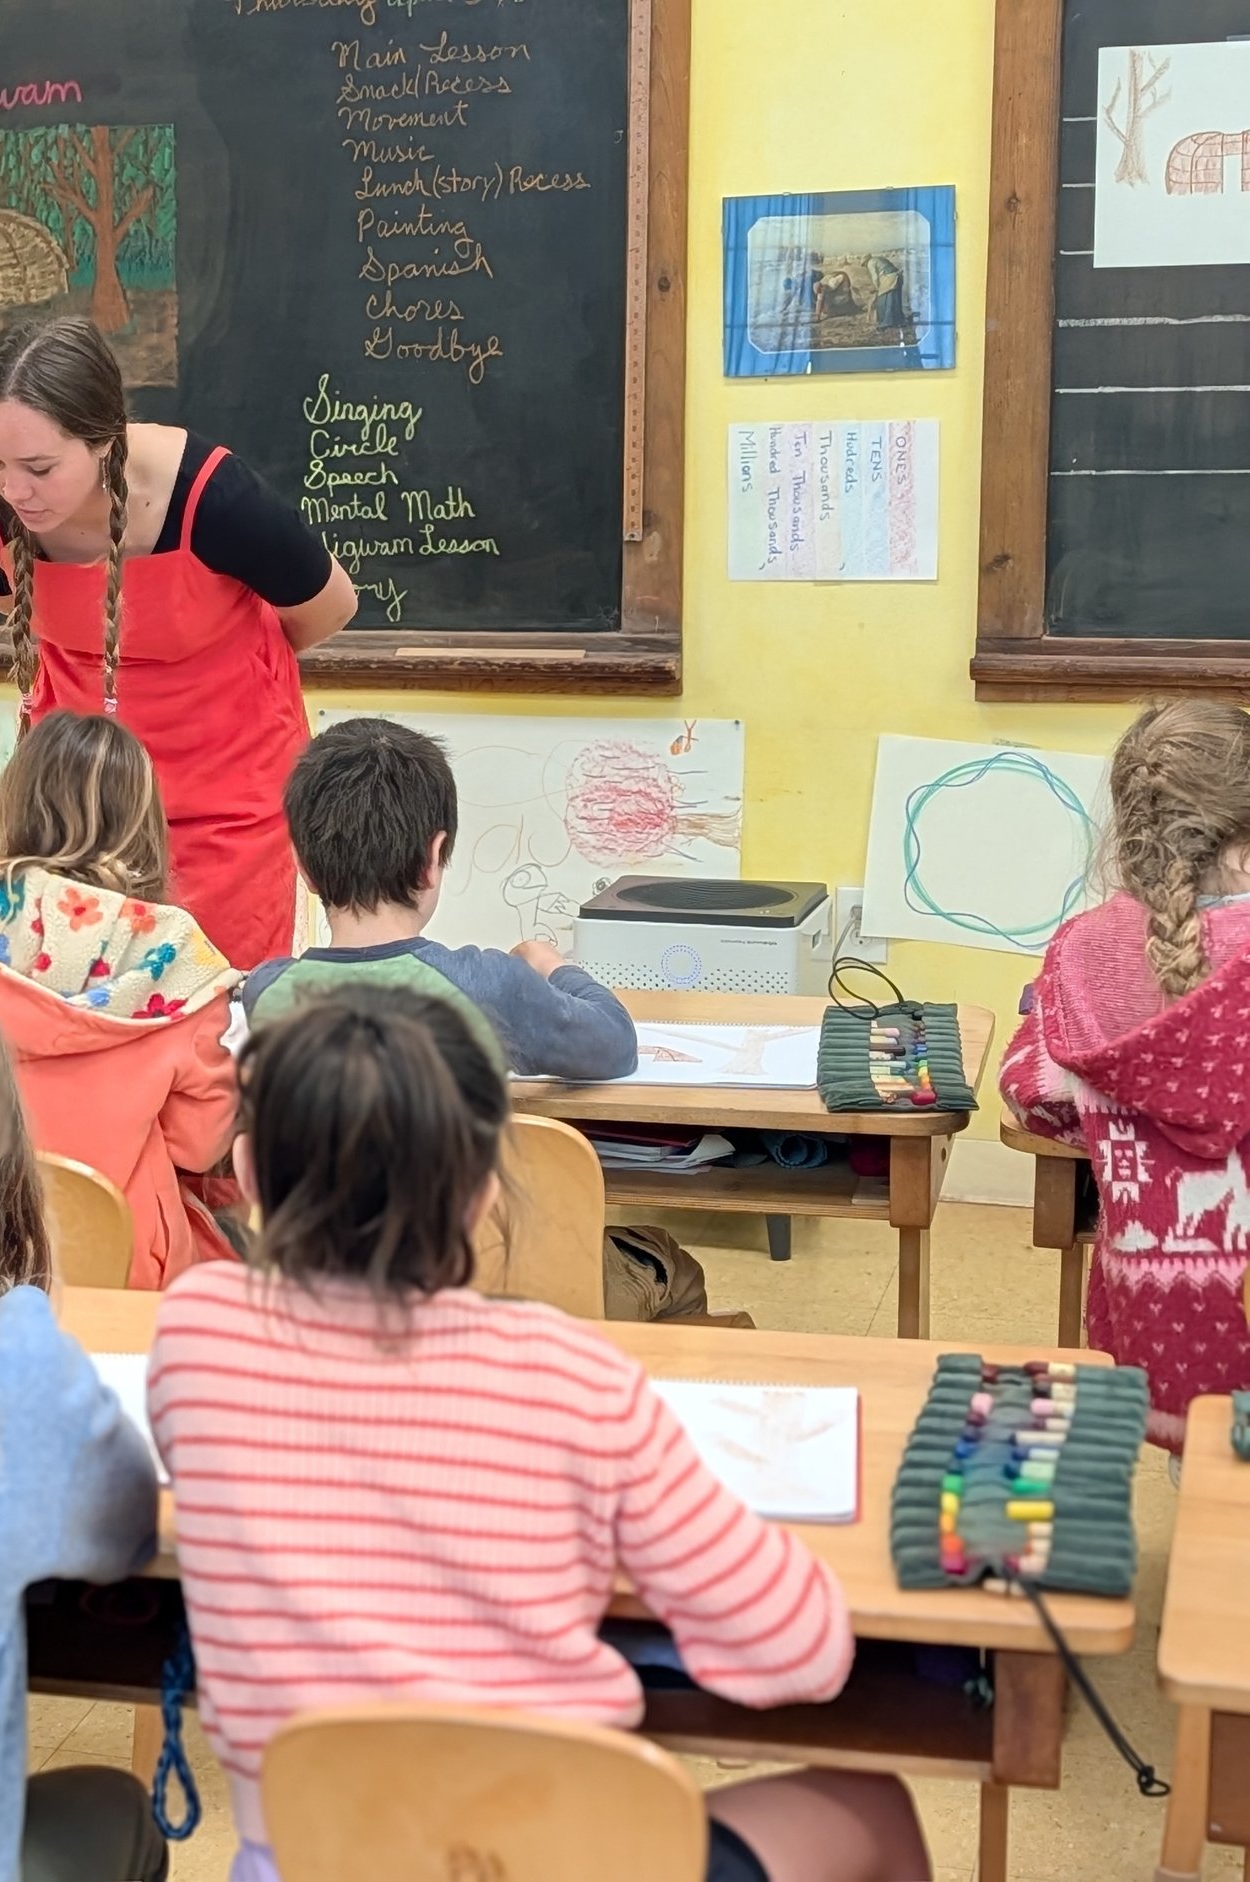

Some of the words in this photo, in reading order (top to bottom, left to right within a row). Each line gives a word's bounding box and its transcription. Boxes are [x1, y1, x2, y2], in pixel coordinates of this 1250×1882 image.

[332, 39, 407, 71] Main
[419, 31, 531, 64] Lesson
[337, 99, 469, 131] Movement
[342, 137, 435, 163] Music
[358, 203, 474, 258] Painting
[359, 243, 494, 286] Spanish
[364, 326, 503, 385] Goodbye
[303, 373, 423, 441] Singing
[310, 423, 399, 459] Circle
[738, 430, 757, 493] Millions
[768, 427, 782, 474] Hundred
[793, 431, 807, 458] Ten
[870, 436, 882, 483] TENS
[895, 436, 907, 485] ONES
[304, 459, 399, 498] Speech
[819, 430, 835, 521] Thousands
[301, 491, 388, 525] Mental
[401, 486, 476, 524] Math
[767, 487, 783, 564] Thousands
[790, 470, 806, 551] Thousands
[418, 524, 500, 555] Lesson
